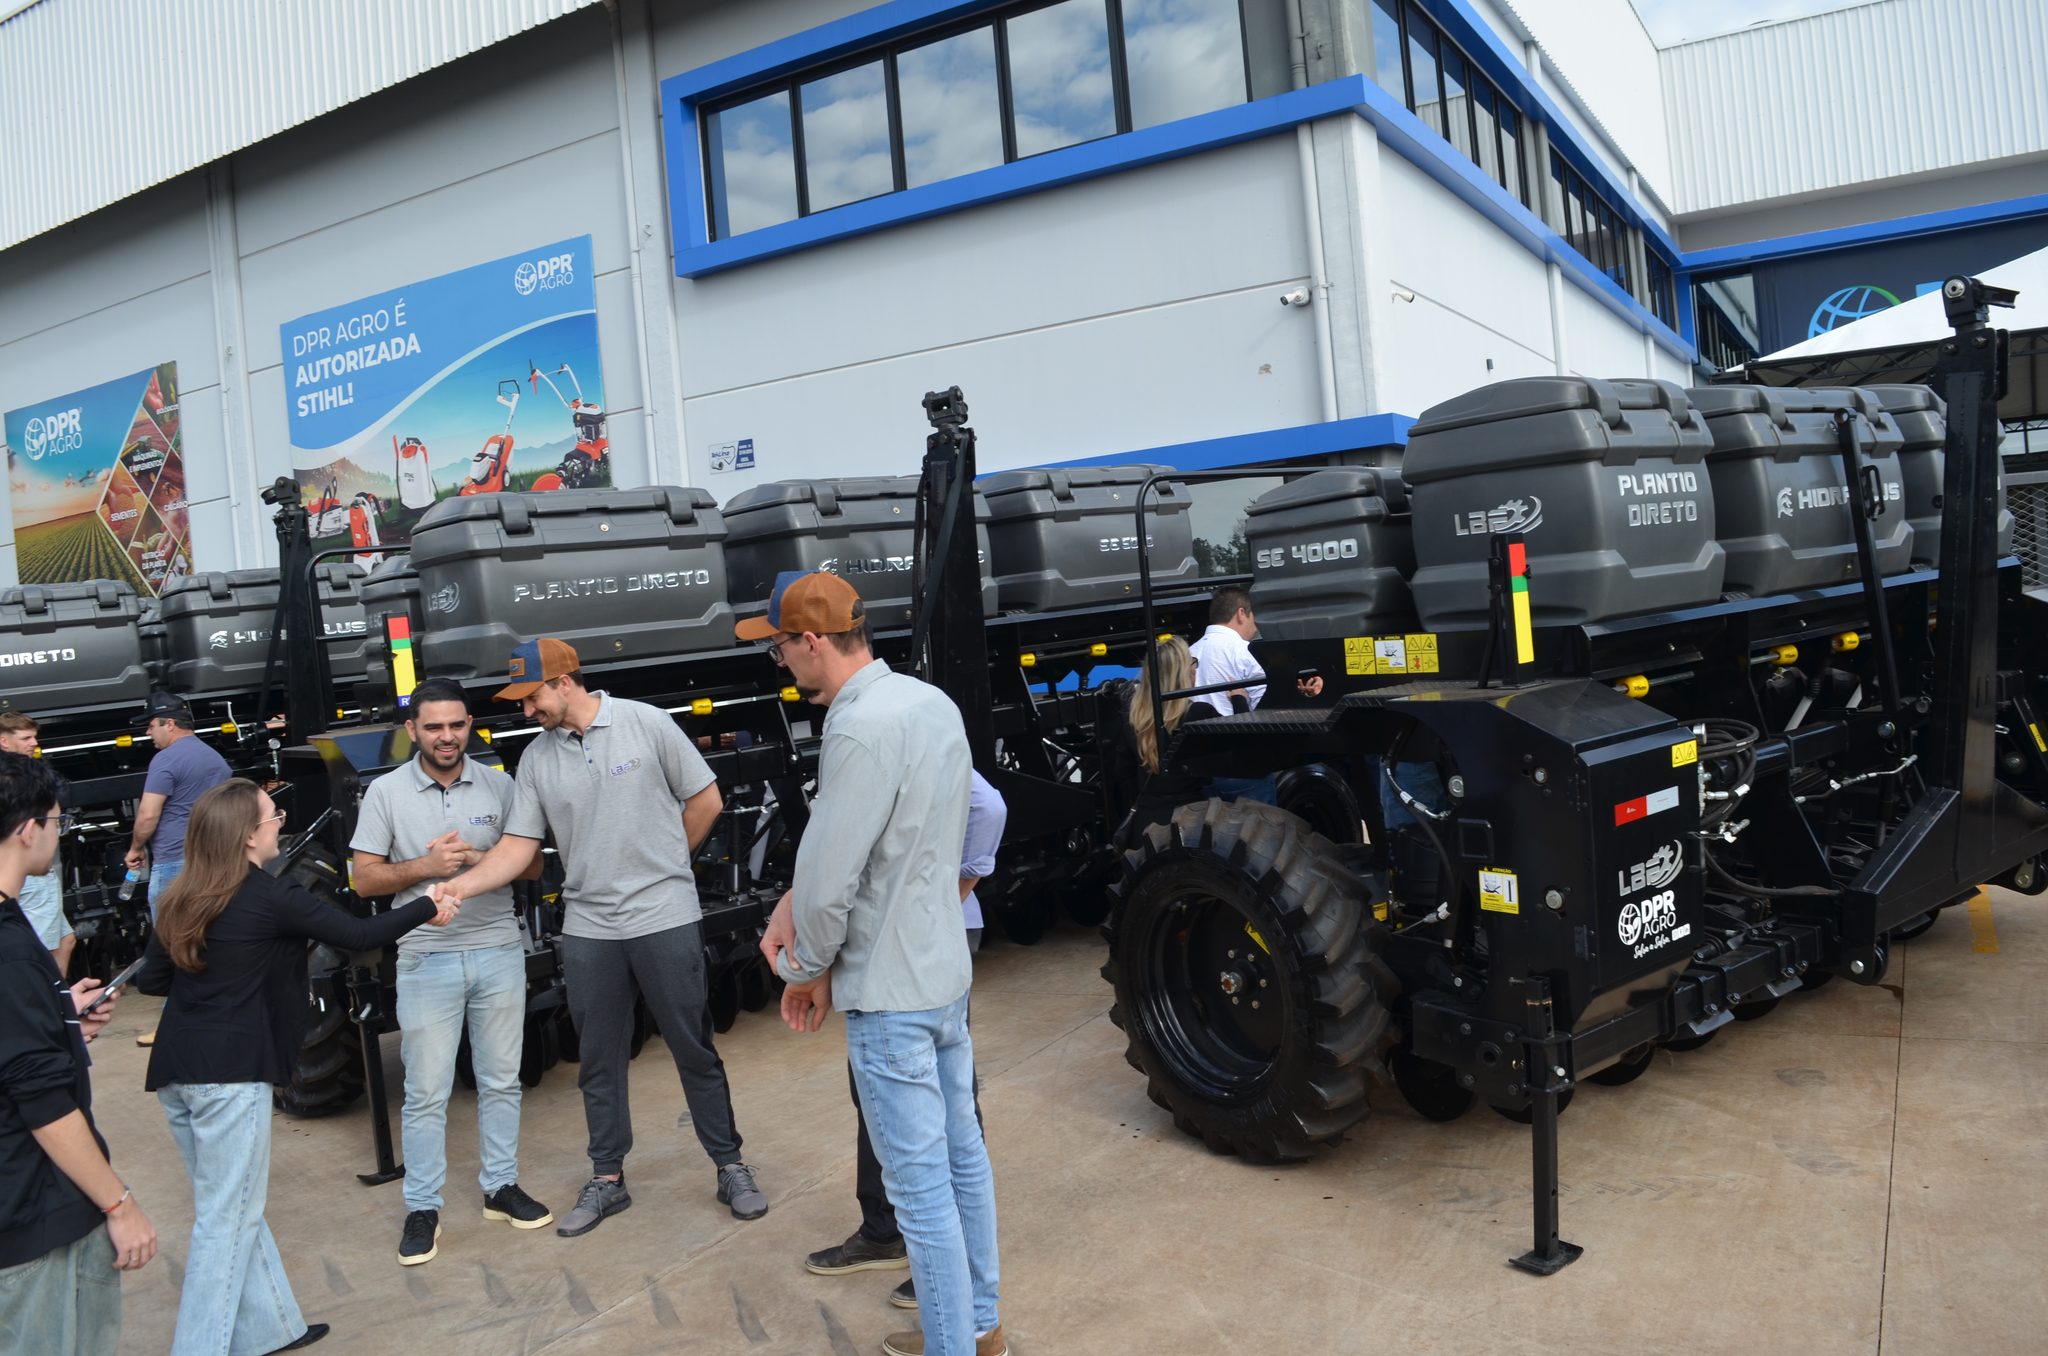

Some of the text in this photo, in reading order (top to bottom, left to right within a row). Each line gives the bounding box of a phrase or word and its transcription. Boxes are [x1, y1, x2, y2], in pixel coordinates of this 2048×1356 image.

[537, 253, 573, 279] DPR
[539, 271, 574, 292] AGRO
[293, 297, 407, 357] DPR AGRO É
[295, 332, 421, 388] AUTORIZADA
[297, 382, 354, 417] STIHL!
[46, 408, 82, 441] DPR
[48, 433, 83, 457] AGRO
[1617, 471, 1697, 496] PLANTIO
[1798, 483, 1900, 510] HIDRUS
[110, 509, 138, 522] SEMENTES
[1627, 501, 1697, 527] DIRETO
[1257, 538, 1358, 569] SE 4000
[513, 569, 710, 602] PLANTIO DIRETO
[234, 620, 367, 644] HIDLUS
[0, 648, 76, 668] DIRETO
[1641, 890, 1676, 924] DPR
[1643, 911, 1676, 939] AGRO
